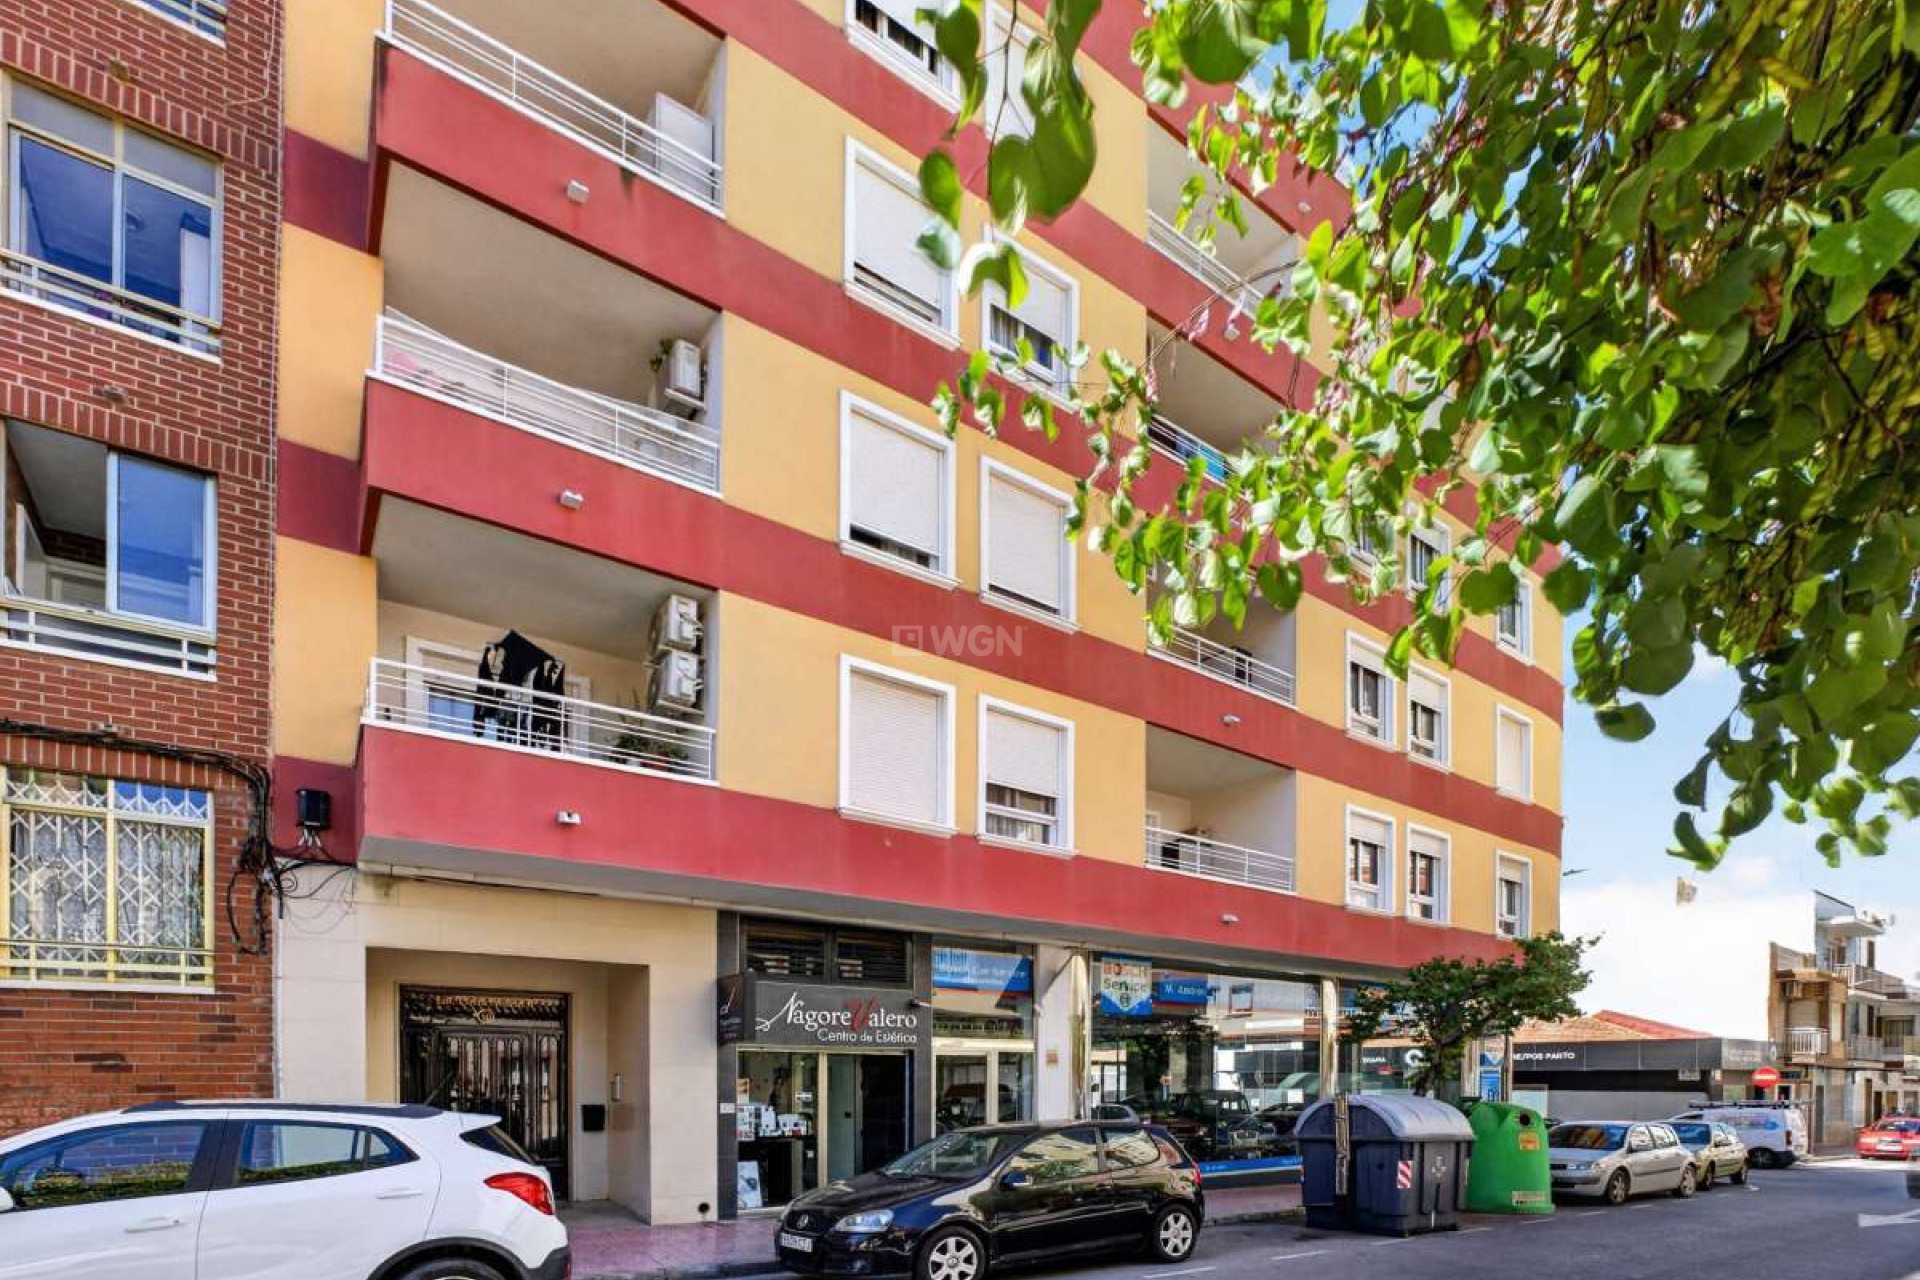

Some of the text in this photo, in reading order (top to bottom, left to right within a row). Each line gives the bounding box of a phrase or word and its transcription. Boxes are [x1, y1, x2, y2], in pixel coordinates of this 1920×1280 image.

[755, 992, 918, 1034] Nagore Valero
[818, 1028, 918, 1044] Centro de Estética
